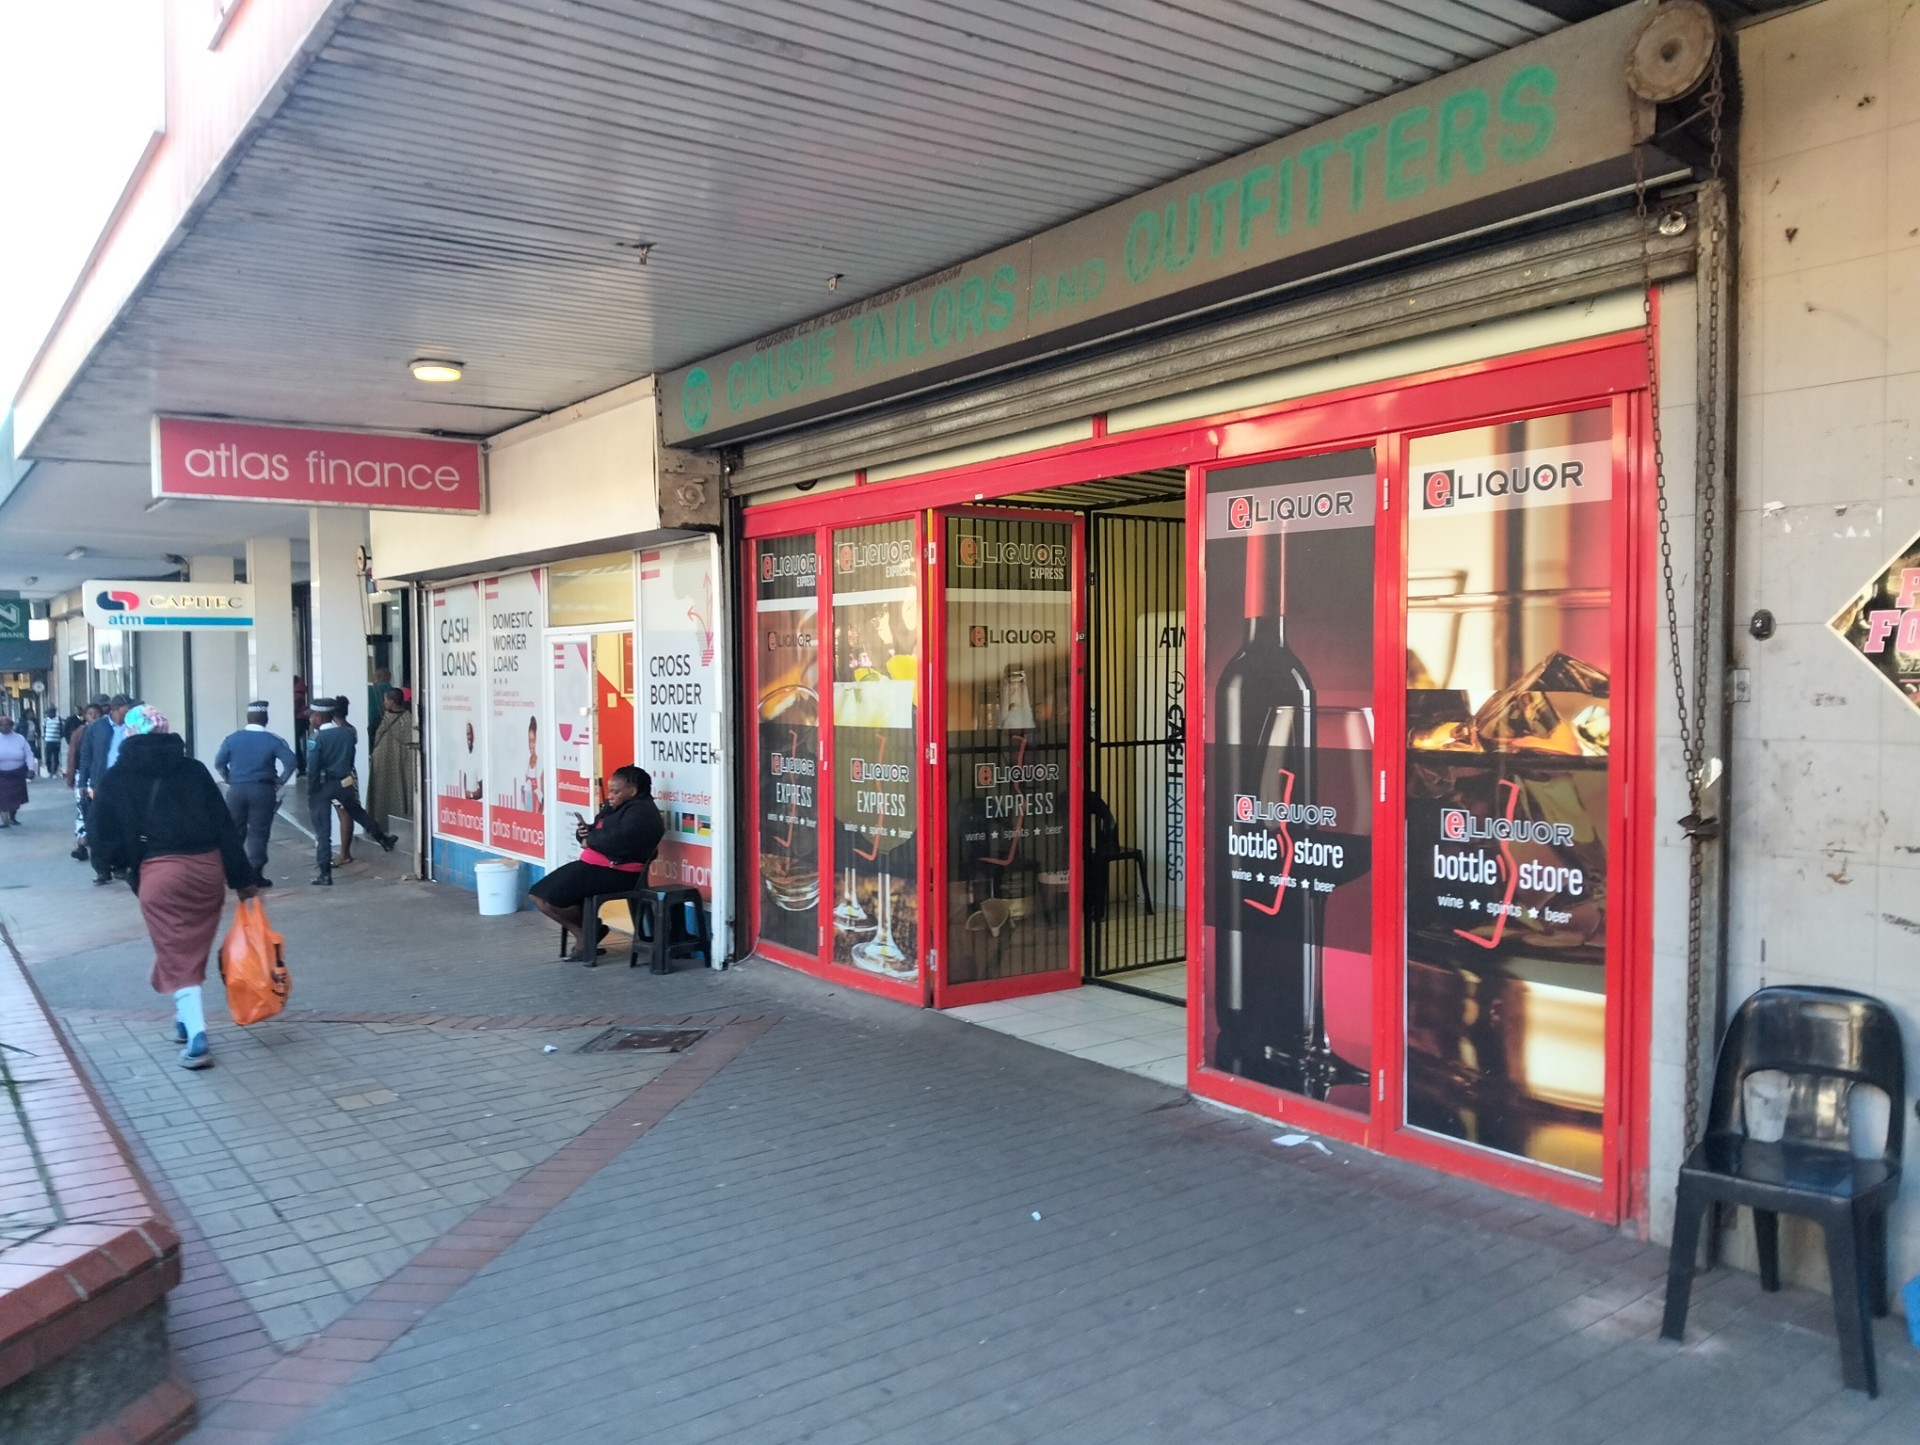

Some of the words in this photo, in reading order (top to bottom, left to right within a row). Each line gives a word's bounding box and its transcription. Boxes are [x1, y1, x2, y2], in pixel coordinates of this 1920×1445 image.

[728, 326, 837, 413] COUSIE
[853, 264, 1017, 374] TAILORS
[1029, 258, 1106, 316] AND
[1123, 63, 1558, 285] OUTFITTERS
[184, 442, 290, 482] atlas
[305, 450, 460, 492] finance
[796, 574, 816, 588] EXPRESS
[885, 561, 911, 578] EXPRESS
[1030, 567, 1064, 580] EXPRESS
[149, 595, 243, 609] CAPITEC
[108, 614, 143, 626] atm
[440, 617, 470, 644] CASH
[492, 611, 534, 630] DOMESTIC
[492, 633, 528, 651] WORKER
[441, 651, 477, 677] LOANS
[493, 655, 520, 673] LOANS
[650, 654, 691, 678] CROSS
[650, 683, 702, 705] BORDER
[651, 712, 698, 734] MONEY
[653, 786, 679, 803] Lowest
[681, 791, 711, 806] transfer
[776, 782, 812, 807] EXPRESS
[857, 790, 906, 817] EXPRESS
[985, 792, 1054, 818] EXPRESS
[511, 821, 544, 847] finance
[965, 831, 986, 842] wine
[1045, 825, 1063, 835] beer
[1228, 825, 1278, 860] bottle
[1294, 838, 1344, 869] store
[1231, 867, 1252, 881] wine
[1269, 873, 1297, 888] spirits
[1314, 878, 1335, 893] beer
[1433, 844, 1497, 885] bottle
[1519, 859, 1583, 895] store
[1437, 893, 1464, 909] wine
[1486, 901, 1522, 917] spirits
[1544, 906, 1572, 923] beer
